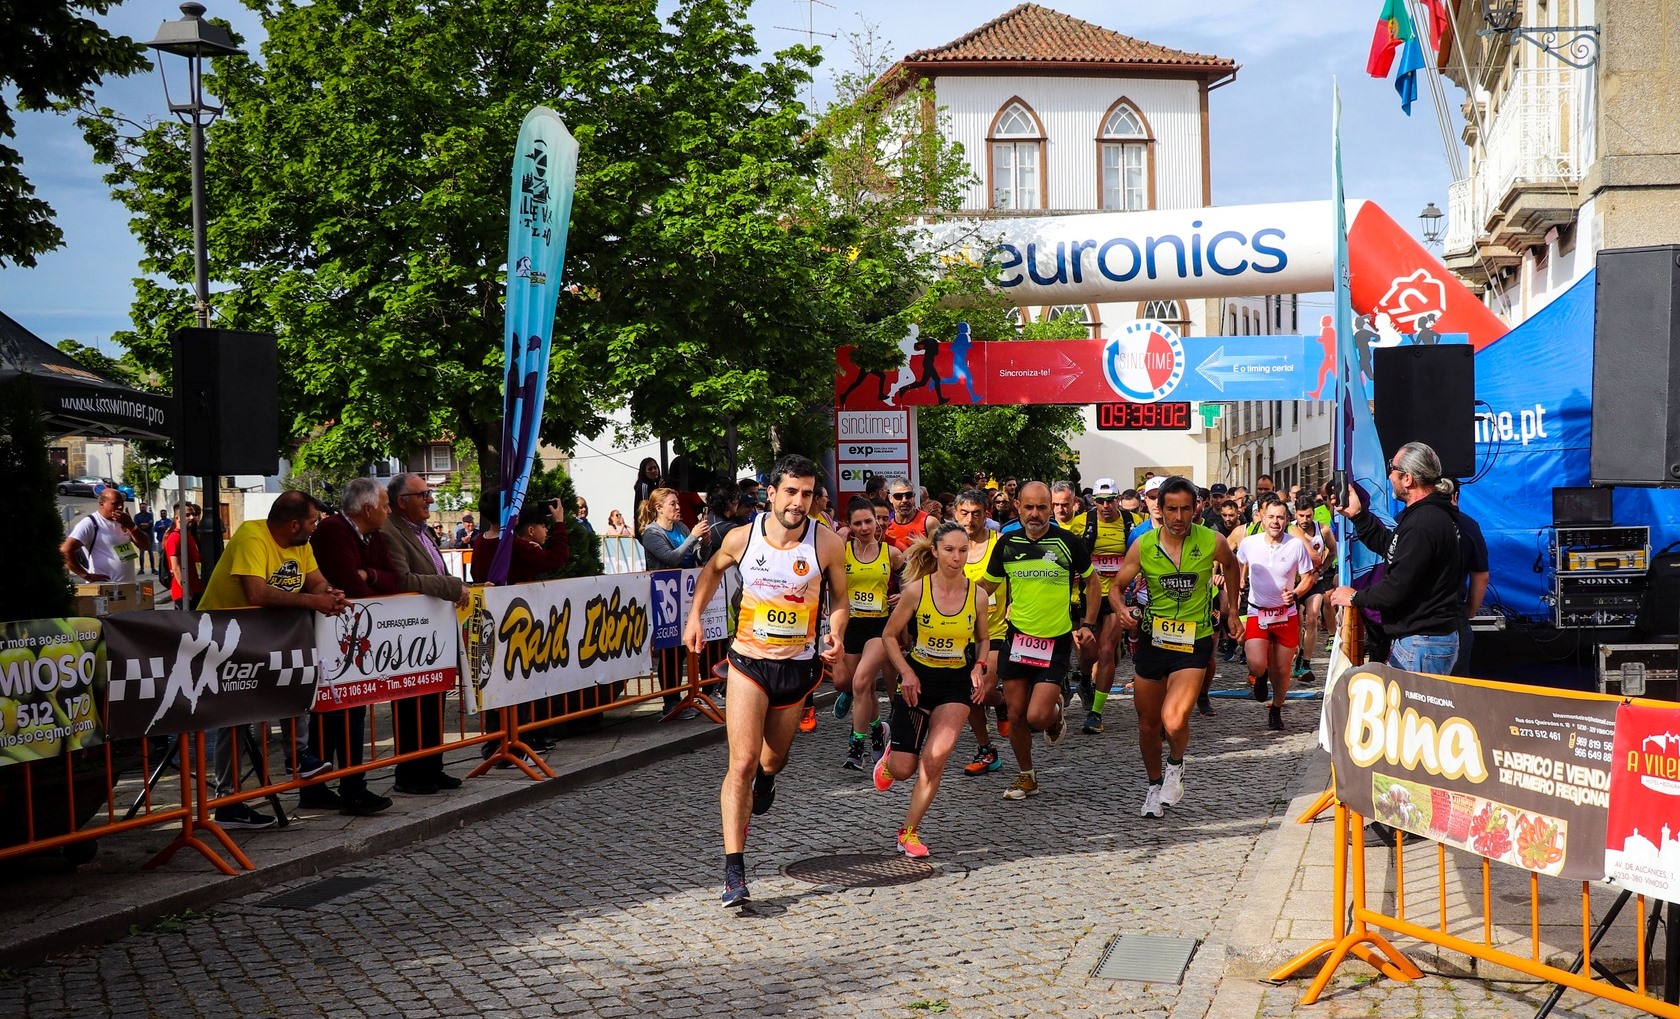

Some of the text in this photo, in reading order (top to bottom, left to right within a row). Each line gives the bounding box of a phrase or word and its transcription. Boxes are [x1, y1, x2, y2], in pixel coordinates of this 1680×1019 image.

[983, 220, 1288, 289] euronics
[1119, 352, 1172, 370] SINCTIME
[1247, 364, 1270, 374] timing
[1271, 364, 1294, 372] certo!
[999, 368, 1051, 377] Sincroniza-te!
[1101, 404, 1187, 427] 09:39:02
[841, 413, 904, 438] sinctime.pt
[1475, 403, 1548, 445] me.pt
[848, 446, 873, 457] exp
[841, 469, 874, 485] exp
[119, 543, 131, 553] 212
[1017, 568, 1059, 578] euronics
[654, 578, 678, 626] RS
[854, 590, 874, 603] 589
[767, 609, 797, 625] 603
[1262, 608, 1285, 617] 1028
[376, 617, 430, 630] CHURRASQUEIRA das
[1161, 620, 1186, 634] 614
[8, 637, 36, 649] mora
[39, 635, 52, 645] ao
[55, 634, 74, 644] seu
[76, 630, 97, 641] lado
[499, 597, 571, 680] Raid
[656, 625, 679, 639] SEGUROS
[325, 602, 446, 681] Rosas
[927, 636, 954, 649] 585
[1019, 637, 1048, 651] 1030
[0, 652, 96, 697] MIOSO
[222, 660, 265, 680] bar
[221, 679, 259, 693] vimioso
[316, 690, 333, 701] Tel.
[333, 686, 348, 698] 73
[348, 684, 362, 696] 106
[363, 682, 377, 693] 344
[387, 679, 402, 690] Tlm.
[402, 676, 416, 687] 962
[417, 674, 430, 685] 445
[430, 671, 443, 683] 949
[17, 701, 54, 728] 512
[65, 692, 91, 719] 170
[1427, 695, 1455, 709] REGIONAL
[1344, 672, 1489, 784] Bina
[1520, 728, 1561, 741] 273 512 461
[1576, 736, 1613, 751] 969 819 56
[1574, 747, 1612, 762] 966 649 88
[1626, 750, 1639, 773] A
[1492, 749, 1553, 779] FABRICO
[1553, 760, 1564, 781] E
[1498, 768, 1514, 785] DE
